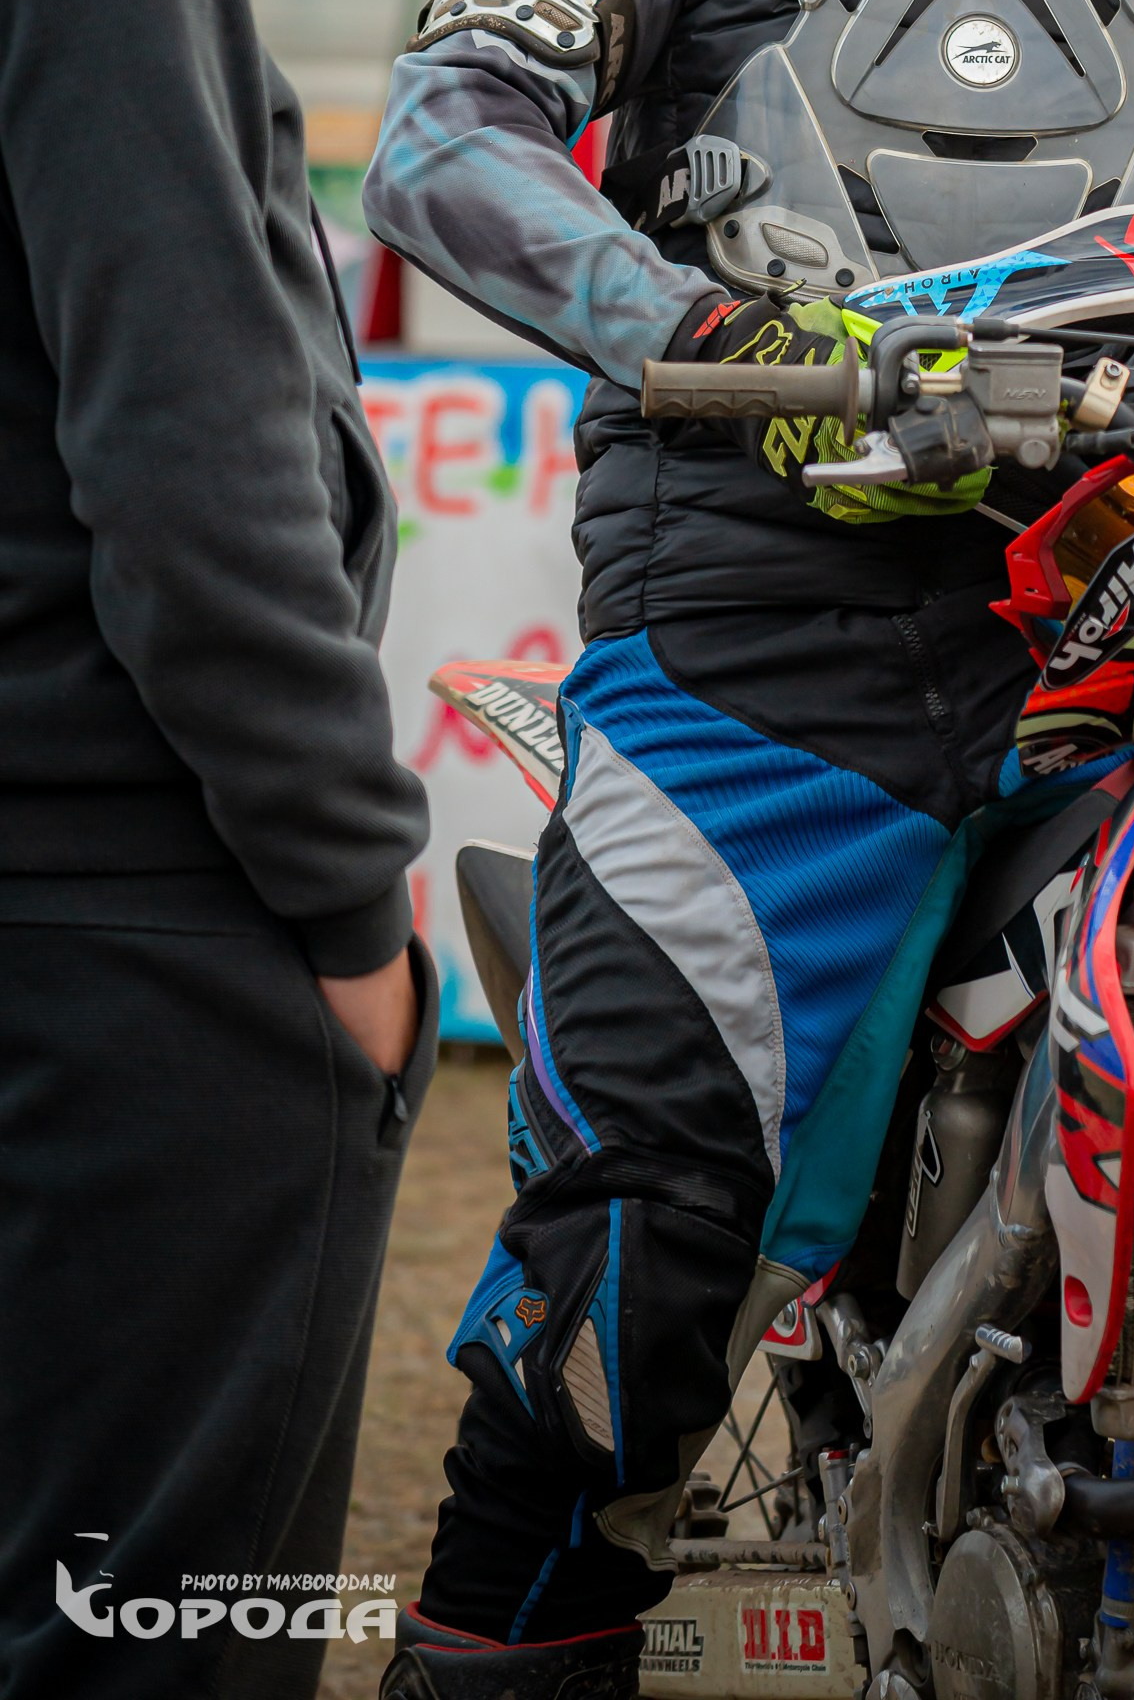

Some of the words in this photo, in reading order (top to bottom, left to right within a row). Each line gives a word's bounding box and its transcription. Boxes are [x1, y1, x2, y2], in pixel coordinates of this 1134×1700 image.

[962, 55, 993, 64] ARCTIC
[994, 55, 1012, 64] CAT
[904, 267, 981, 294] AIROH
[464, 681, 565, 773] DUNLO
